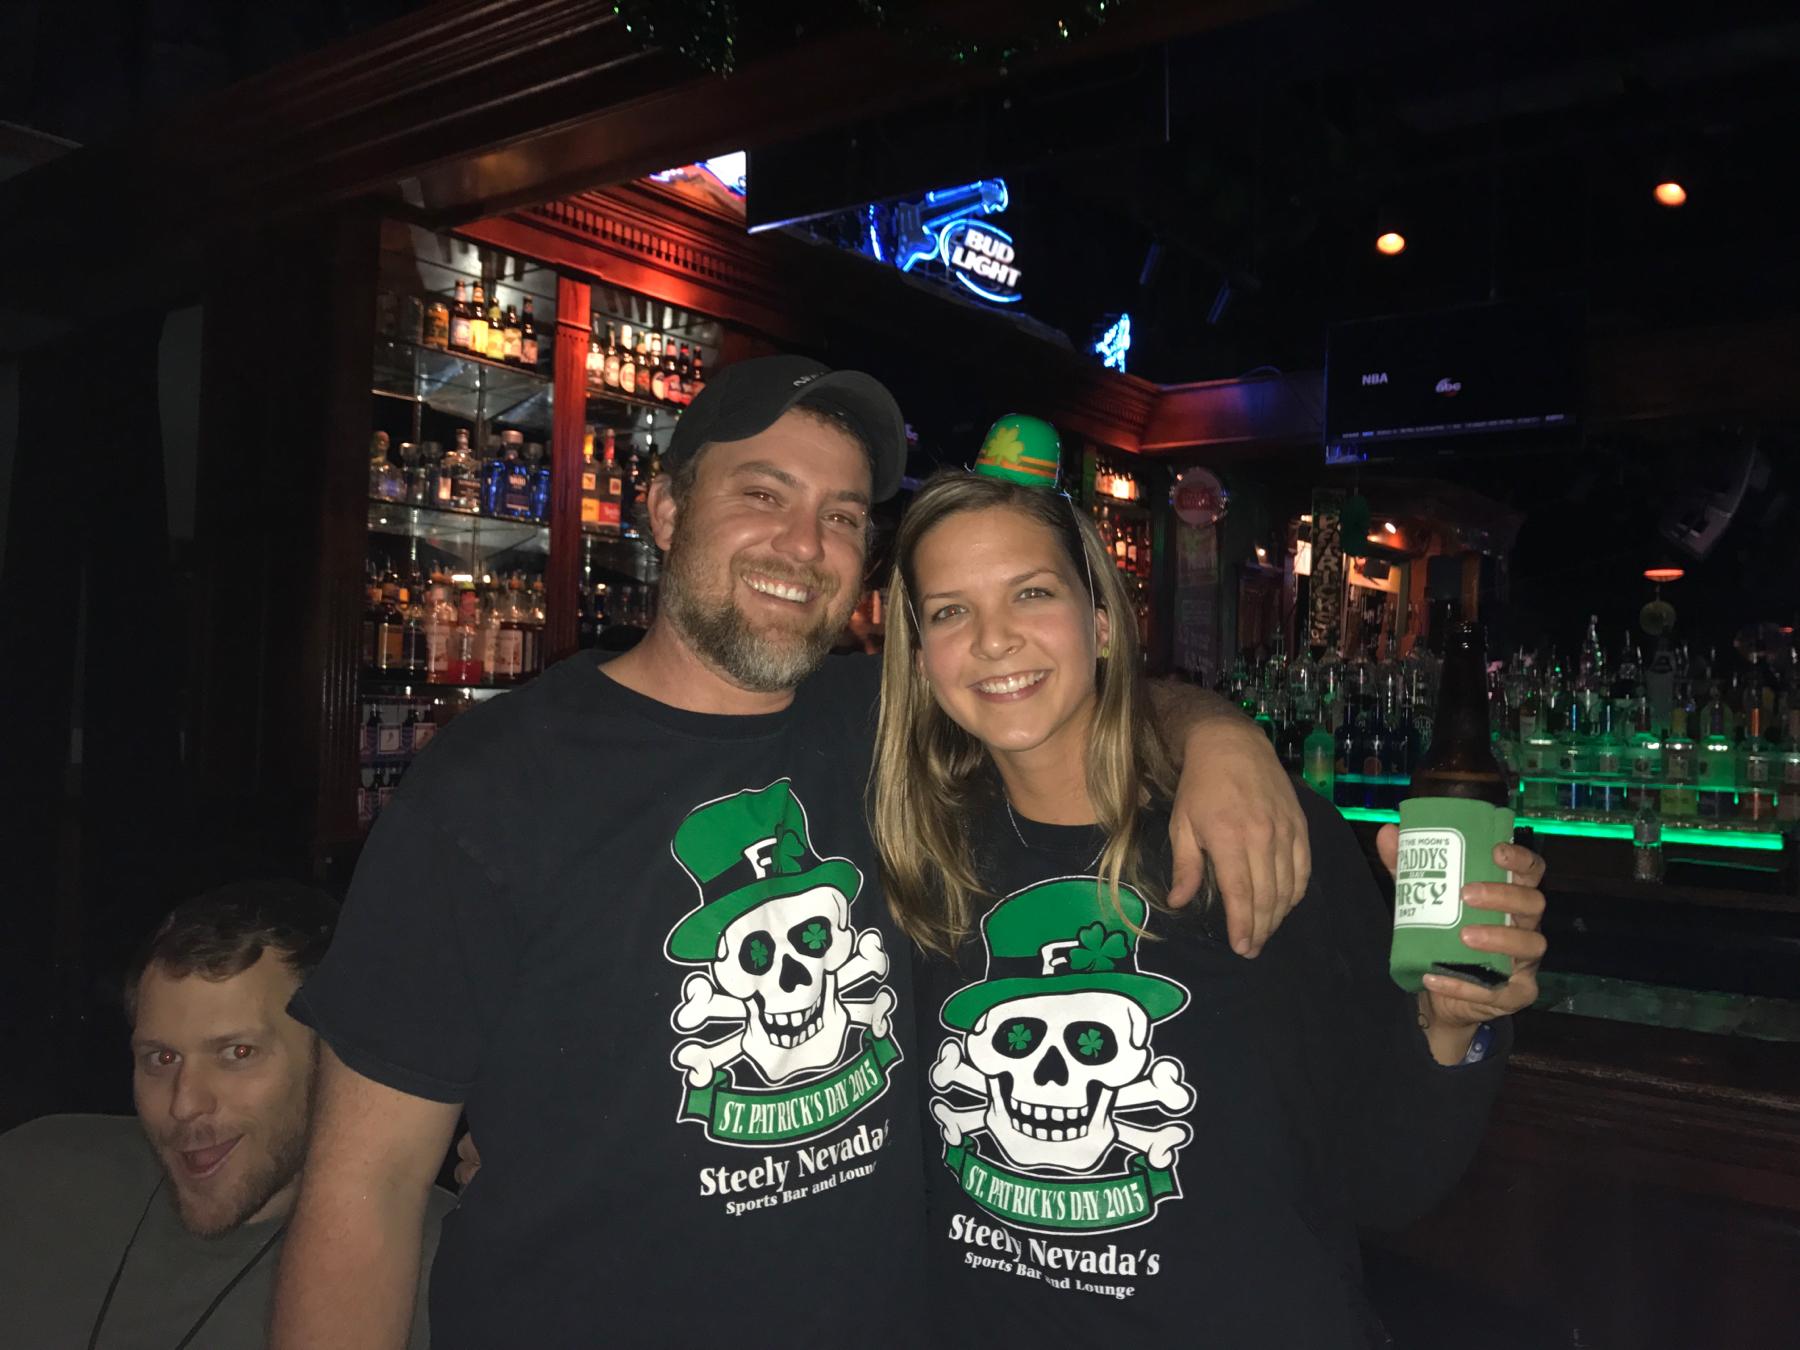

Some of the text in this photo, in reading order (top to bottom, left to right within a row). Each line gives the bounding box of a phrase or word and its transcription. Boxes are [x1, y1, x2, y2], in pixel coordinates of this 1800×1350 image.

[951, 246, 1021, 287] LIGHT
[964, 228, 1015, 263] BUD
[1362, 372, 1388, 386] NBA
[1418, 838, 1450, 847] MOON'S
[719, 1058, 879, 1135] ST. PATRICK'S DAY 2015
[699, 1118, 889, 1197] Steely Nevada
[726, 1161, 877, 1217] Sports Bar and Loun
[964, 1164, 1146, 1221] ST. PATRICK'S DAY 2015
[964, 1251, 1013, 1273] Sports
[1015, 1262, 1043, 1280] Bar
[1075, 1279, 1136, 1301] Lounge
[1028, 1237, 1161, 1277] Nevada's
